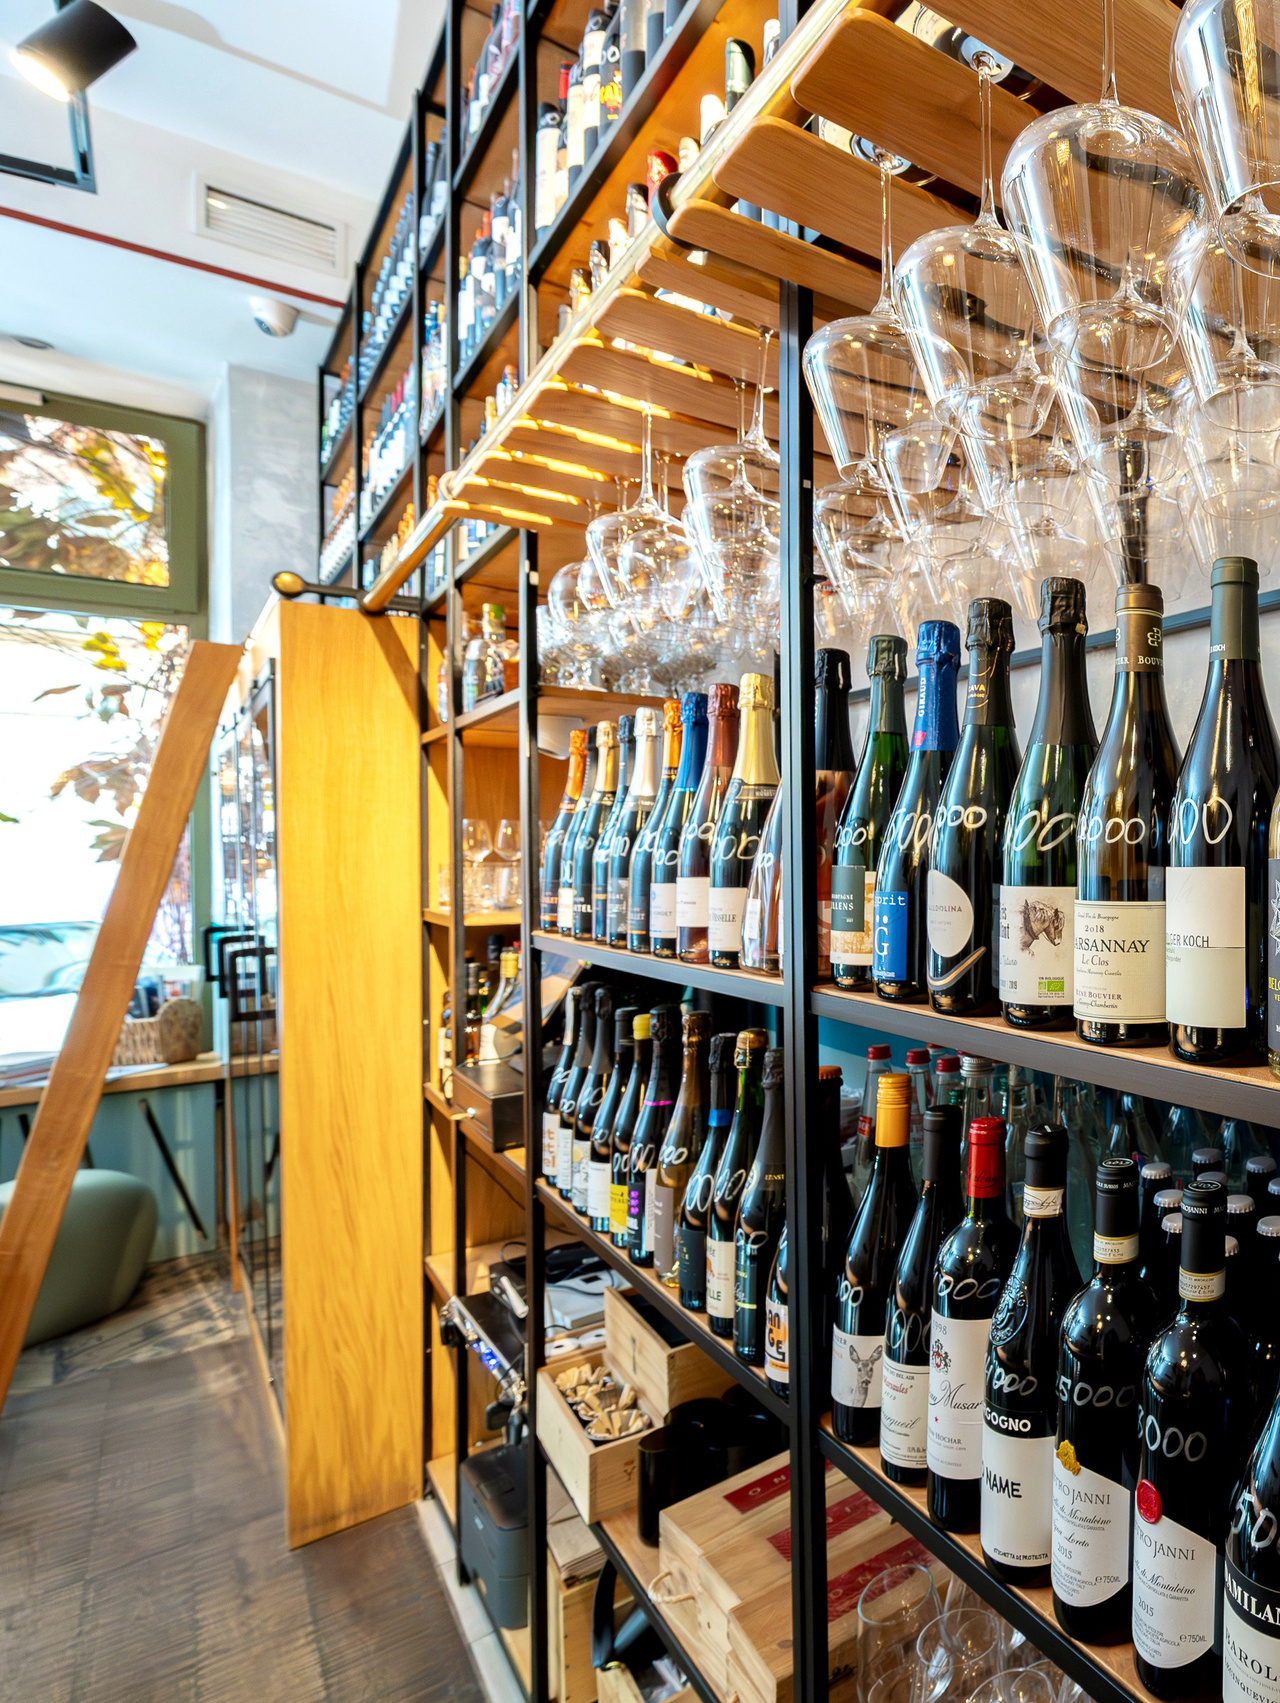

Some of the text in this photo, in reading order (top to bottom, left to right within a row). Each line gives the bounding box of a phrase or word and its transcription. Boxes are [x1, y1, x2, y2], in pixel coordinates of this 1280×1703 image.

[1138, 656, 1163, 665] BOUV
[918, 677, 926, 717] GIRAUD
[1084, 924, 1105, 933] 2018
[1183, 934, 1210, 947] KOCH
[1091, 954, 1109, 966] Clos
[1088, 991, 1123, 1001] BOUVIER
[930, 1379, 983, 1410] Musar
[935, 1432, 962, 1445] HOCHAR
[986, 1467, 1022, 1499] NAME
[1067, 1508, 1111, 1526] Montalcino
[1064, 1531, 1090, 1548] Loreto
[1022, 1553, 1049, 1561] PROTESTA
[1057, 1541, 1073, 1560] 2015
[1103, 1575, 1120, 1584] 750ML
[1148, 1573, 1196, 1595] Montalcino
[1138, 1596, 1154, 1617] 2015
[1188, 1634, 1207, 1643] 750ML
